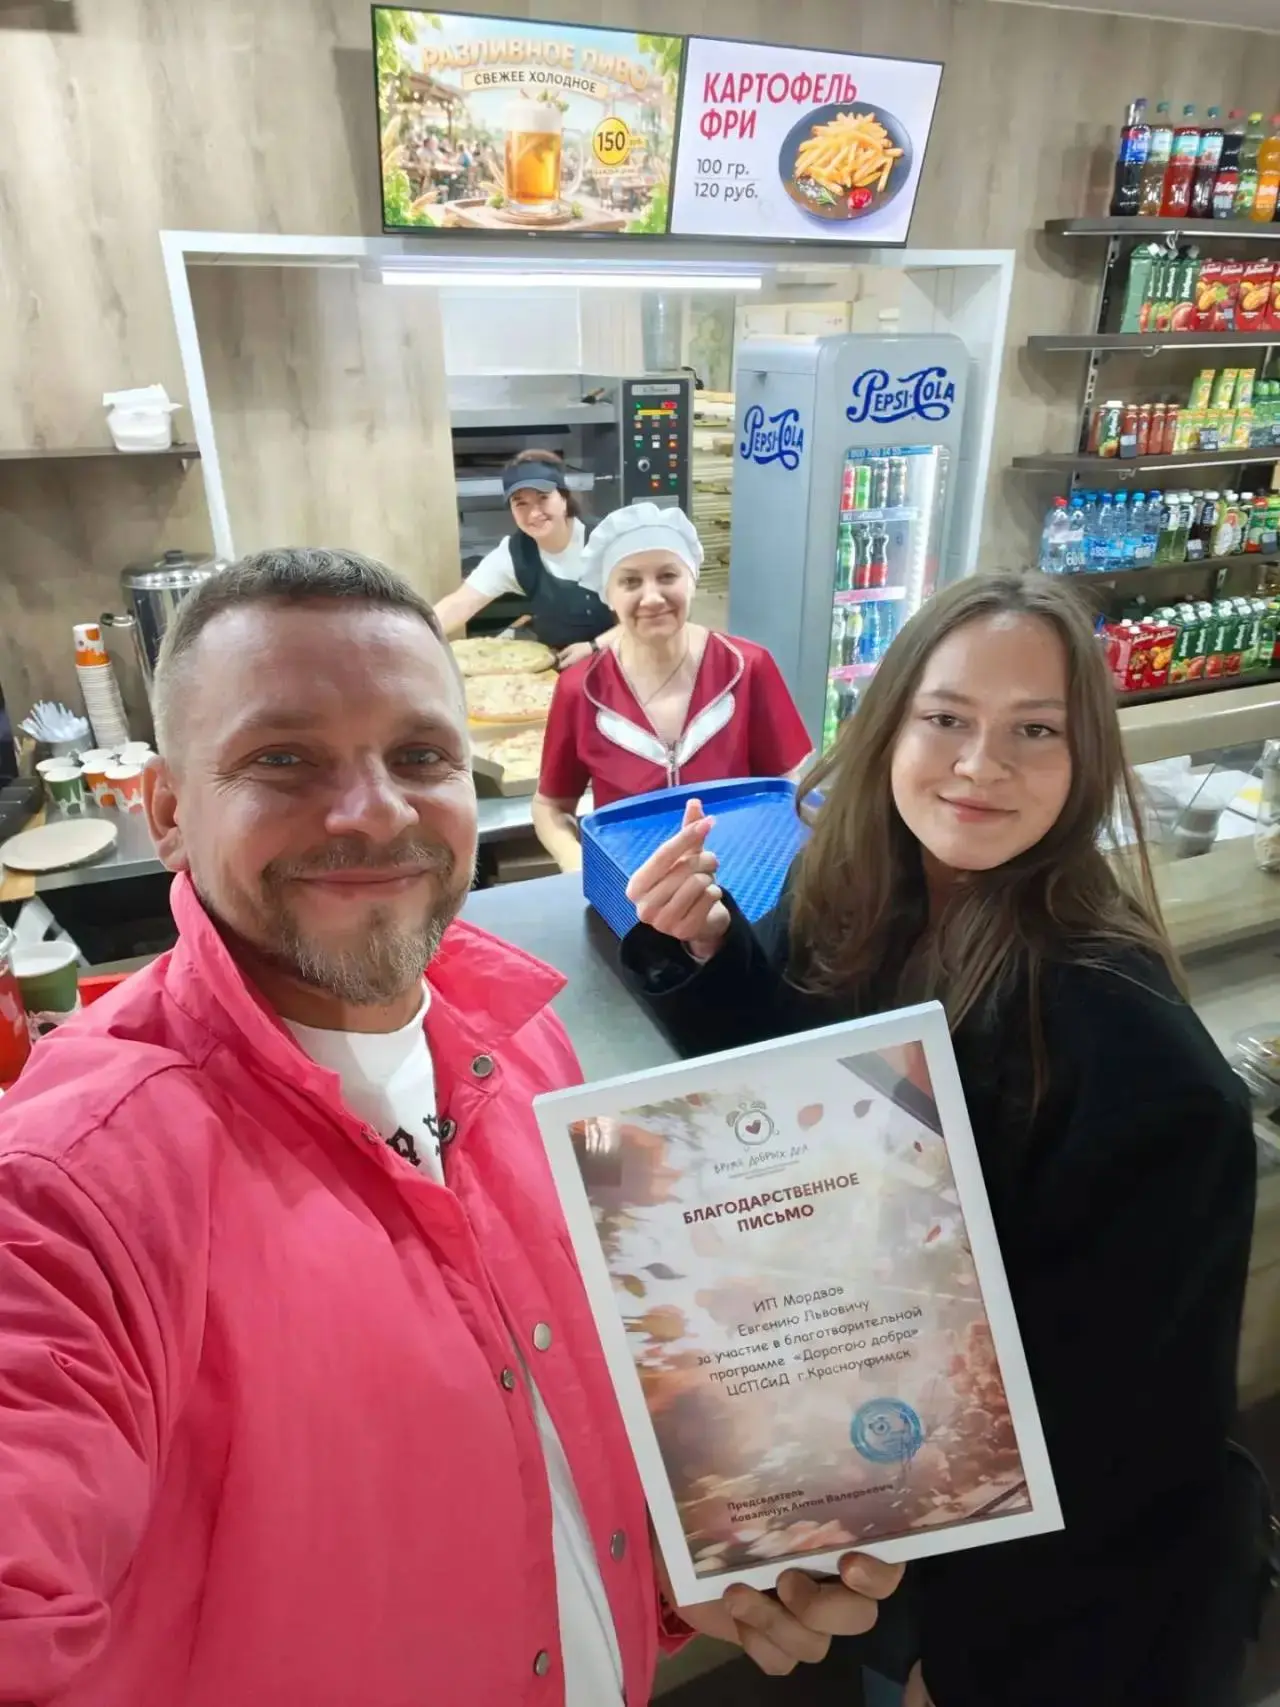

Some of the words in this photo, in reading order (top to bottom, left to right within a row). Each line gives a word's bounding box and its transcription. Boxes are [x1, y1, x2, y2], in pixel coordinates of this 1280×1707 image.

[474, 70, 525, 86] СВЕЖЕЕ
[529, 71, 597, 93] ХОЛОДНОЕ
[703, 72, 858, 105] КАРТОФЕЛЬ
[700, 108, 757, 140] ФРИ
[597, 131, 626, 152] 150
[697, 158, 722, 174] 100
[727, 163, 750, 179] гр.
[694, 183, 720, 198] 120
[724, 184, 758, 202] руб.
[683, 1172, 860, 1225] БЛАГОДАРСТВЕННОЕ
[737, 1203, 814, 1233] ПИСЬМО
[752, 1296, 778, 1313] ИП
[737, 1315, 800, 1337] Евгению
[804, 1300, 870, 1323] Львовичу
[697, 1355, 712, 1366] за
[714, 1342, 769, 1364] участие
[773, 1339, 781, 1349] в
[784, 1306, 922, 1346] благотворительной
[709, 1358, 786, 1382] программе
[727, 1488, 805, 1511] Председатель
